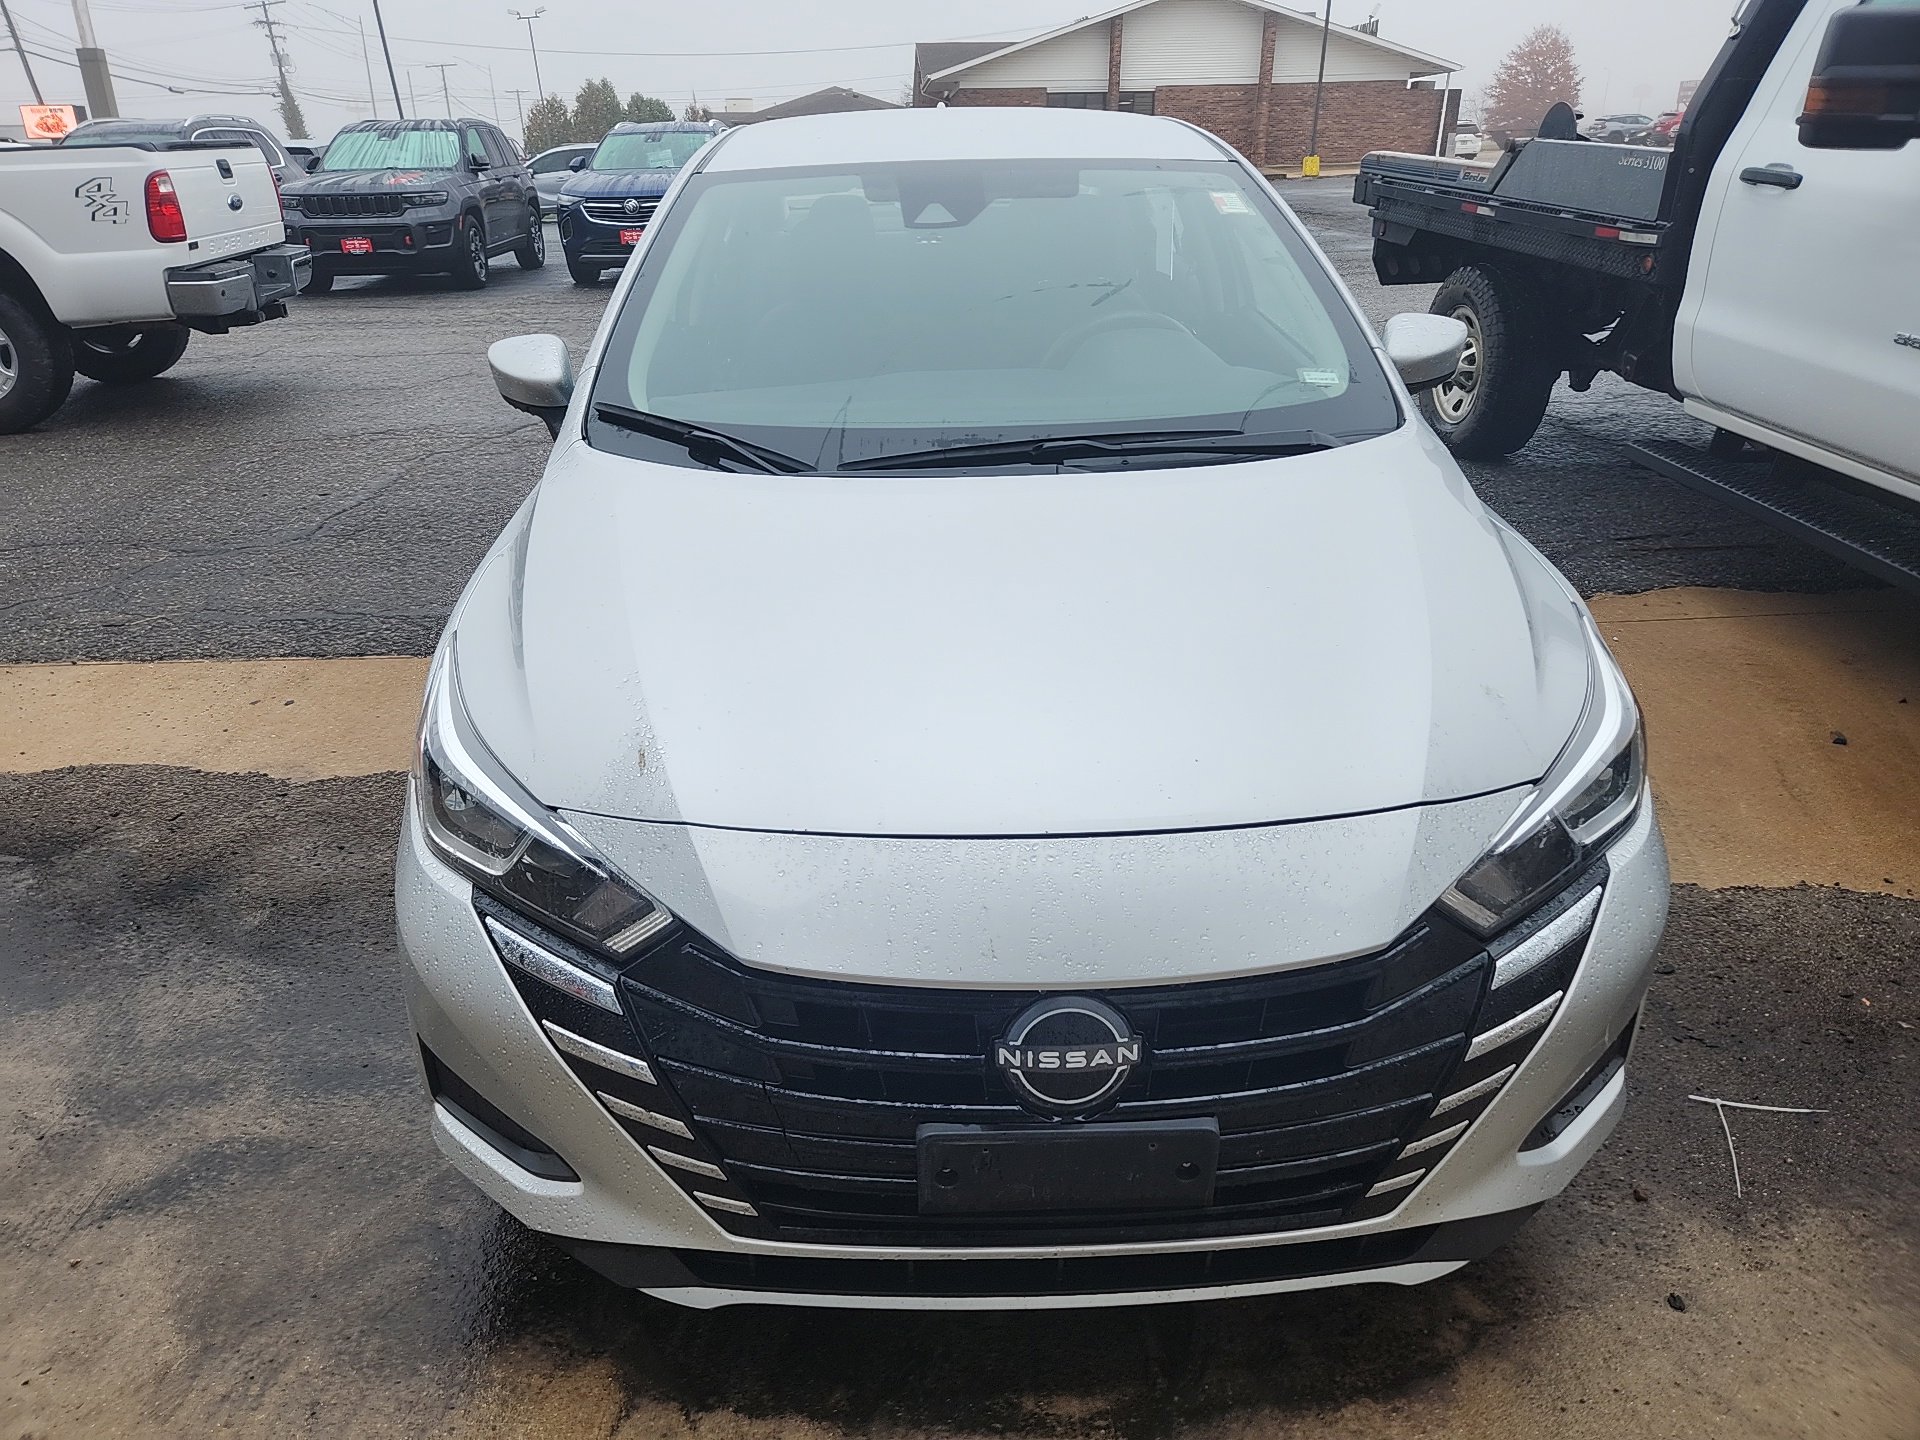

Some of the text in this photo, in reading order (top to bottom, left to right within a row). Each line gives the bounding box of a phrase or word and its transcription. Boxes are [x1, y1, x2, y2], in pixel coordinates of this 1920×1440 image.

[1618, 154, 1666, 171] Series 3100
[998, 1043, 1139, 1069] NISSAN
